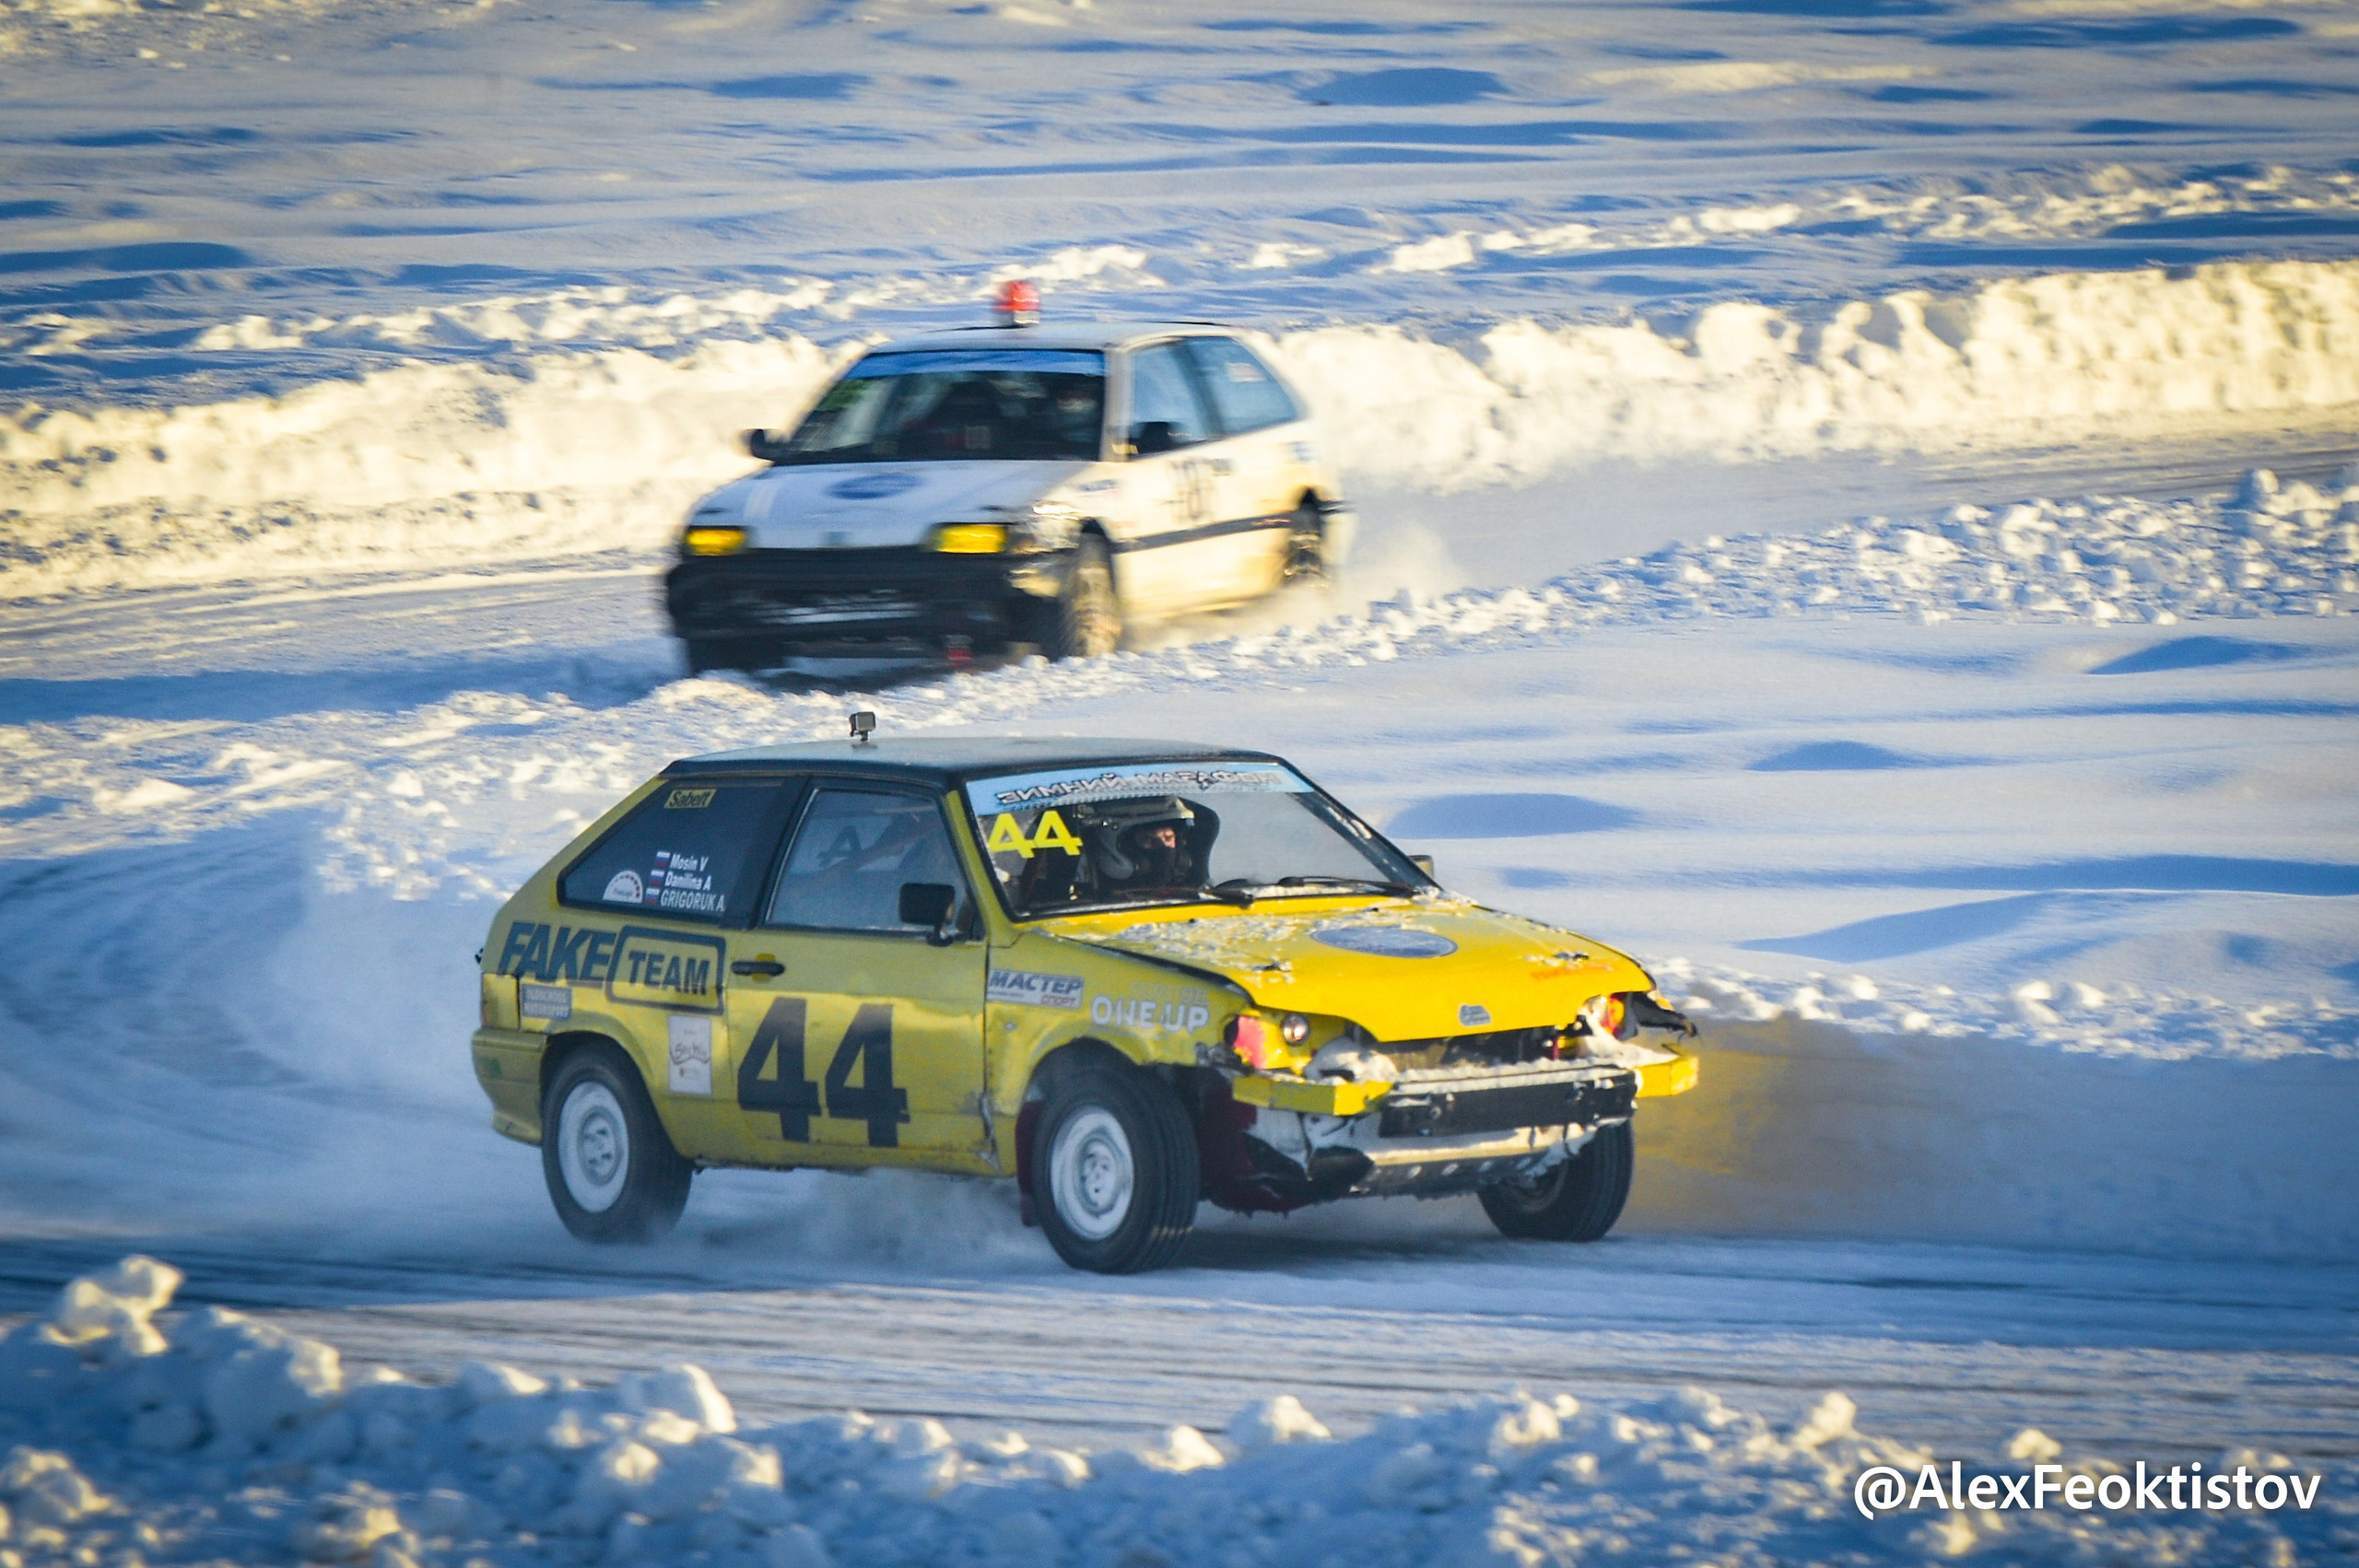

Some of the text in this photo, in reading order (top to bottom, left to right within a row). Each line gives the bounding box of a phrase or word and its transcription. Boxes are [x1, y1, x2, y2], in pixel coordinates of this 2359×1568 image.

[988, 810, 1083, 859] 44
[669, 853, 709, 872] Mosin V
[703, 876, 712, 891] A
[660, 889, 716, 911] GRIGORUK
[496, 921, 710, 996] FAKE TEAM
[989, 971, 1082, 994] МАСТЕР
[1164, 1001, 1209, 1034] UP
[738, 997, 910, 1148] 44
